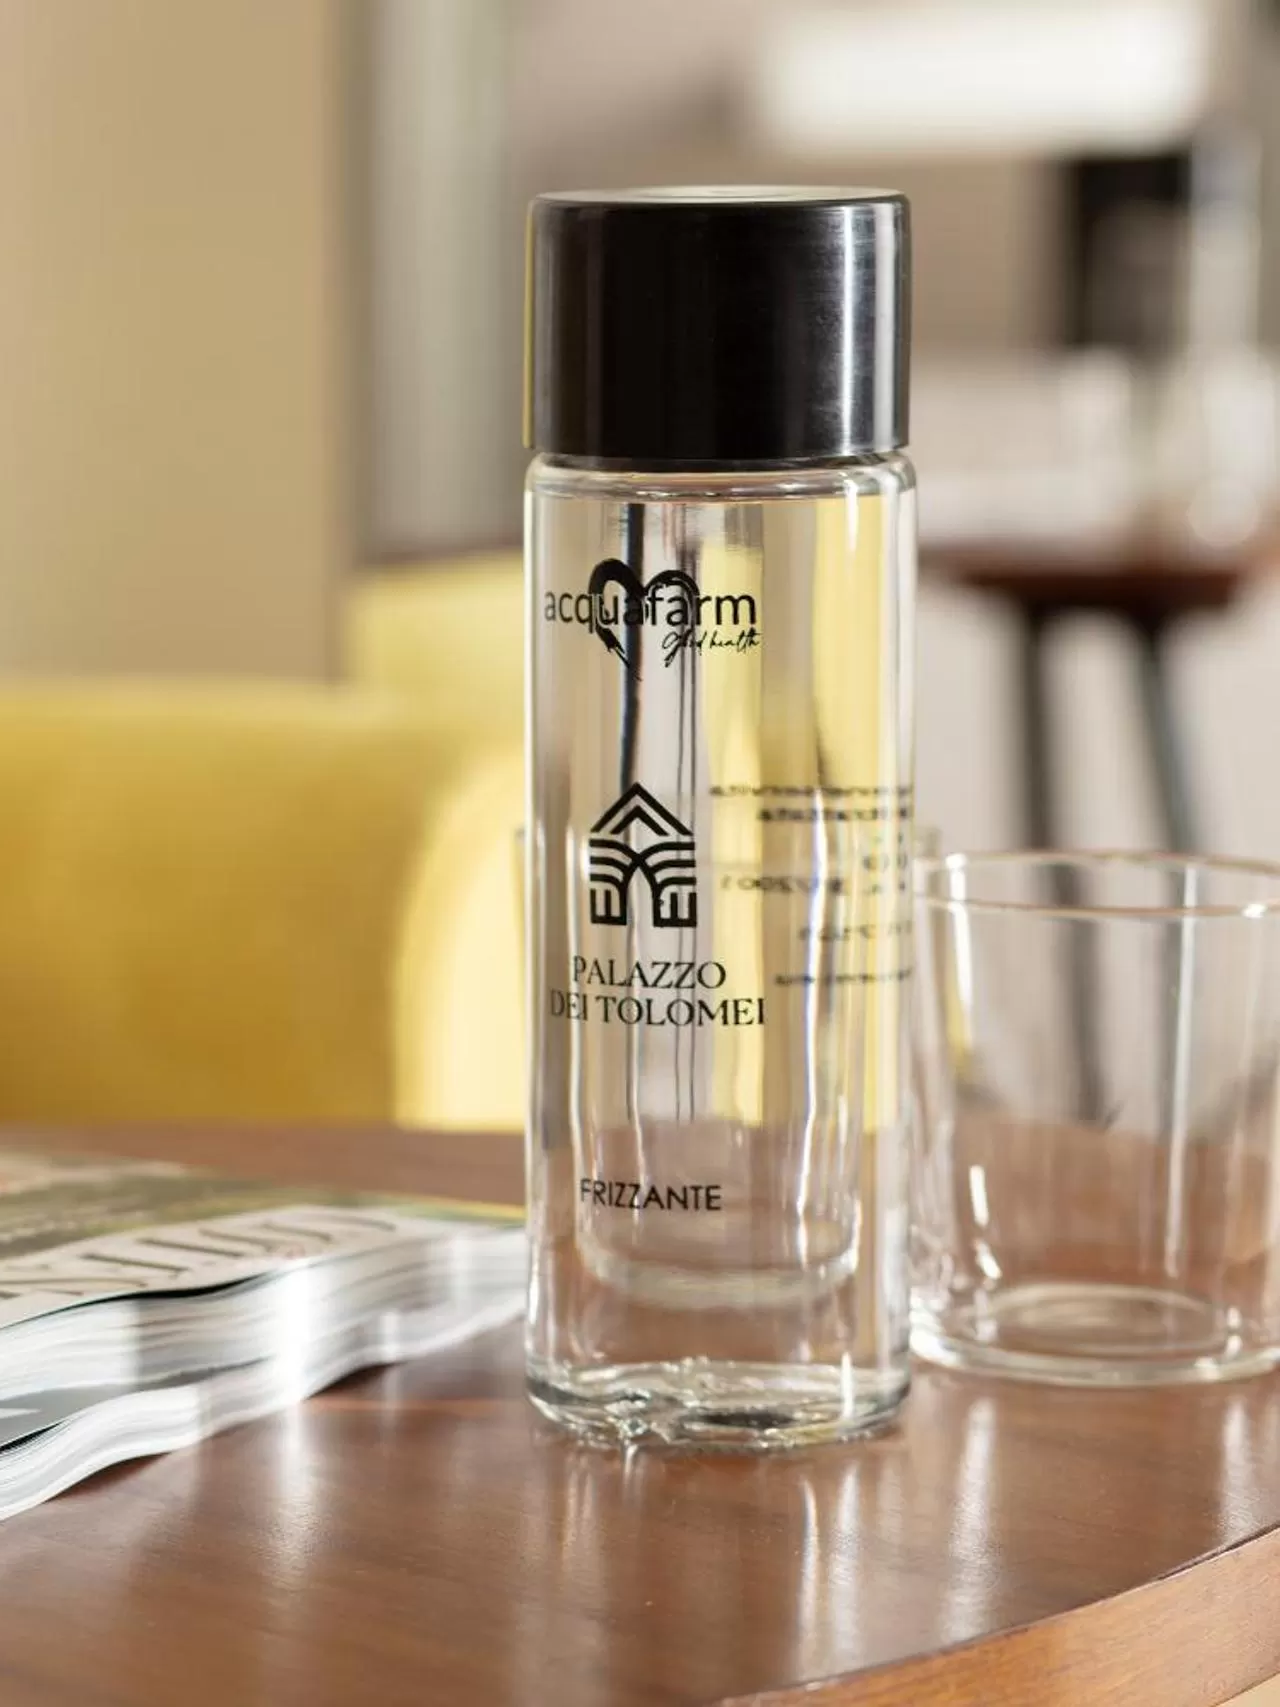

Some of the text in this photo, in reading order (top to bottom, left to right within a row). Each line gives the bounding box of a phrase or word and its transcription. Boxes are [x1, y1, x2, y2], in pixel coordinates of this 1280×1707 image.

[544, 582, 757, 634] acquafarm
[572, 955, 727, 990] PALAZZO
[549, 989, 765, 1026] DEI TOLOMEI
[579, 1178, 722, 1212] FRIZZANTE
